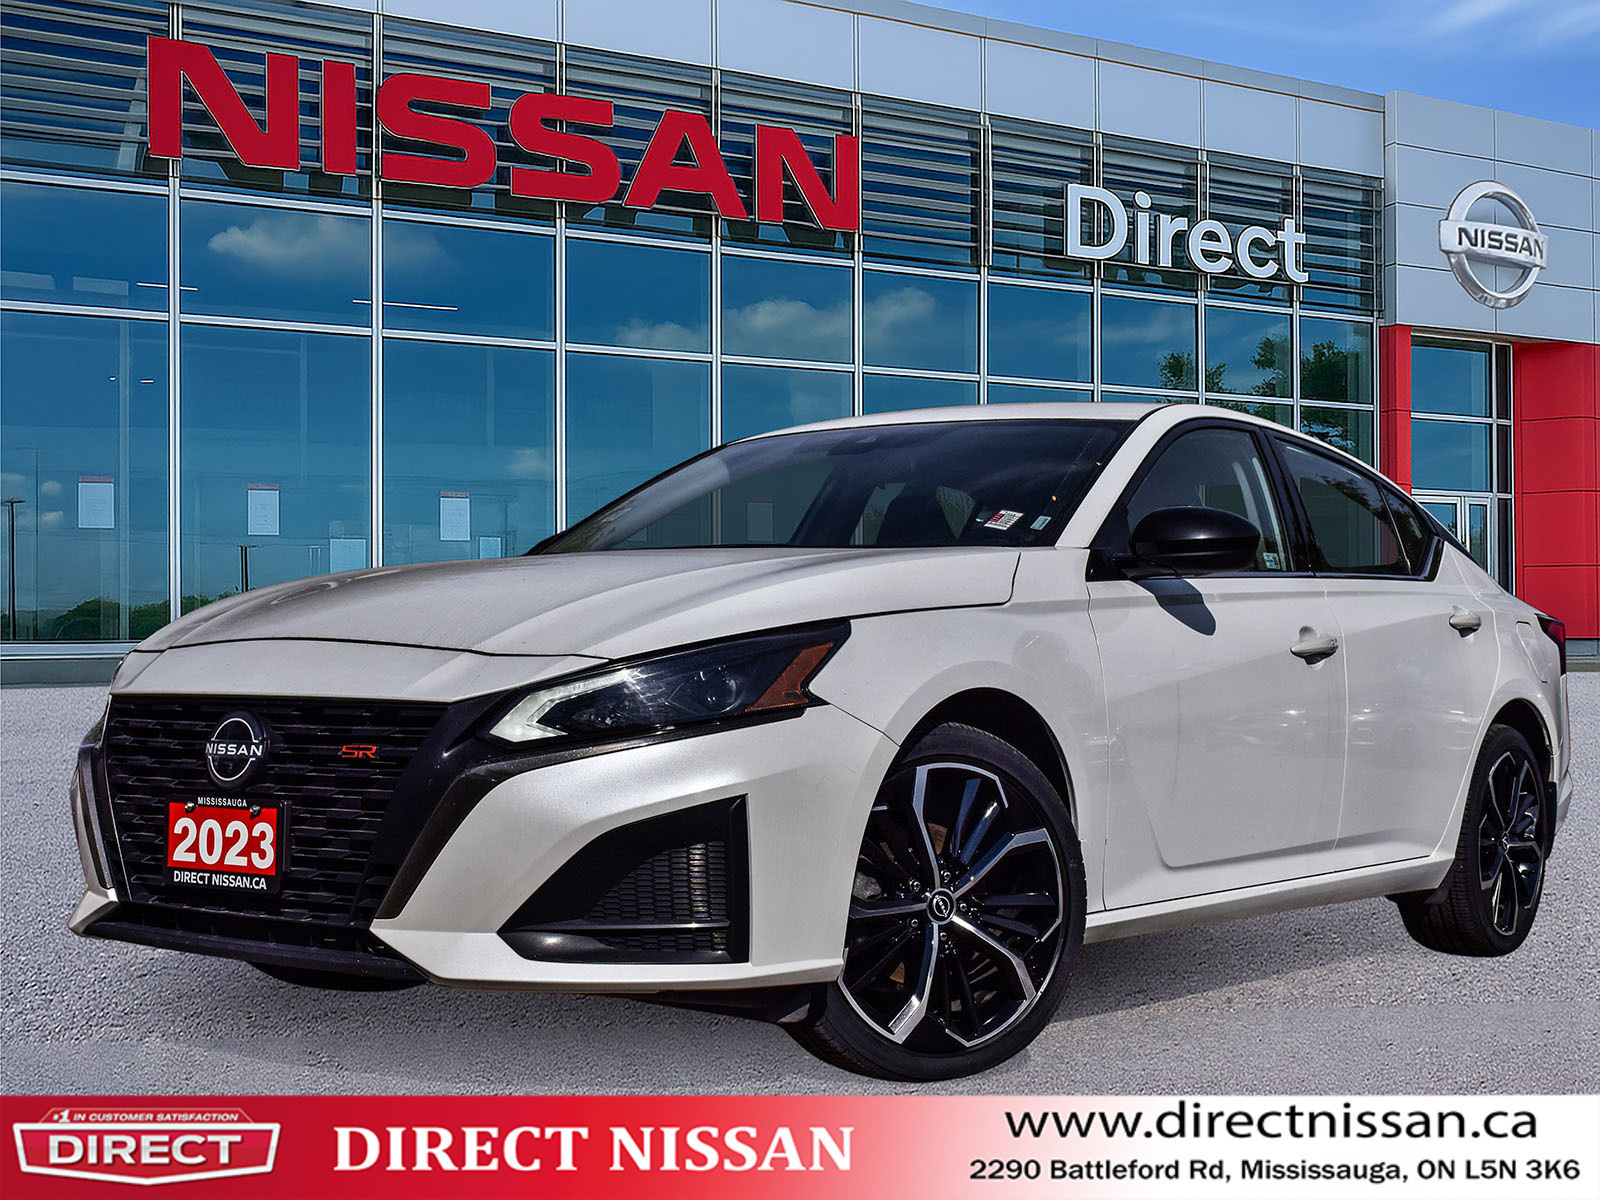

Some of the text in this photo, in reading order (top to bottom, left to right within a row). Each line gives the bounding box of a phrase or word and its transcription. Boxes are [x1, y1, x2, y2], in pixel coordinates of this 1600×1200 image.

[147, 36, 860, 232] NISSAN
[1066, 183, 1309, 283] Direct
[1457, 226, 1544, 260] NISSAN
[205, 742, 264, 757] NISSAN
[341, 744, 378, 759] SR
[197, 796, 248, 808] MISSISSAUGA
[172, 817, 275, 869] 2023
[173, 870, 267, 890] DIRECT NISSAN.CA
